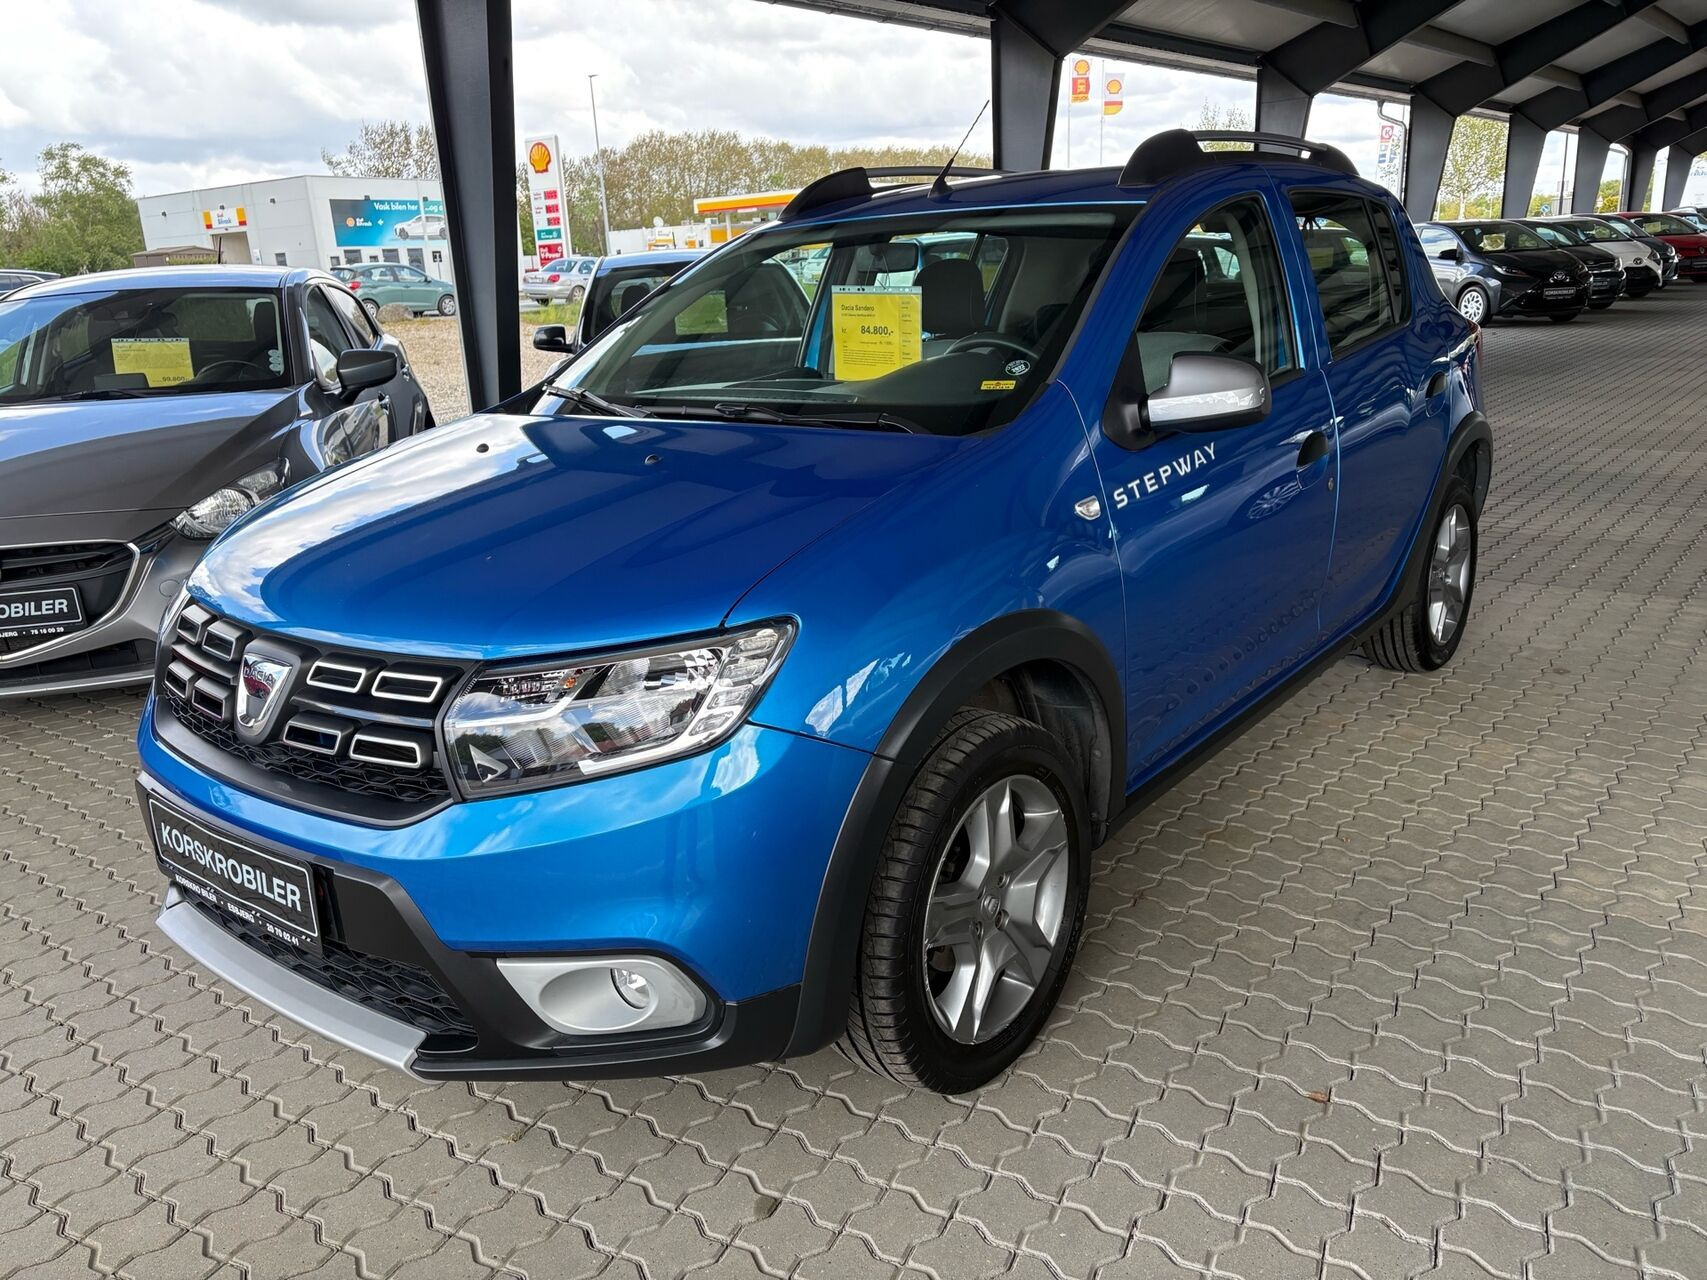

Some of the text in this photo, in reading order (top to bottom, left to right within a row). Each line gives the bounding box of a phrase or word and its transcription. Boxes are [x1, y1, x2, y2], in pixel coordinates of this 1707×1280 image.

[374, 201, 390, 210] Vask
[390, 201, 407, 210] bilen
[407, 202, 418, 210] her
[860, 325, 894, 336] 84.800,-
[1113, 442, 1216, 509] STEPWAY
[161, 822, 302, 912] KORSKROBILER
[227, 902, 255, 923] ESBJERG
